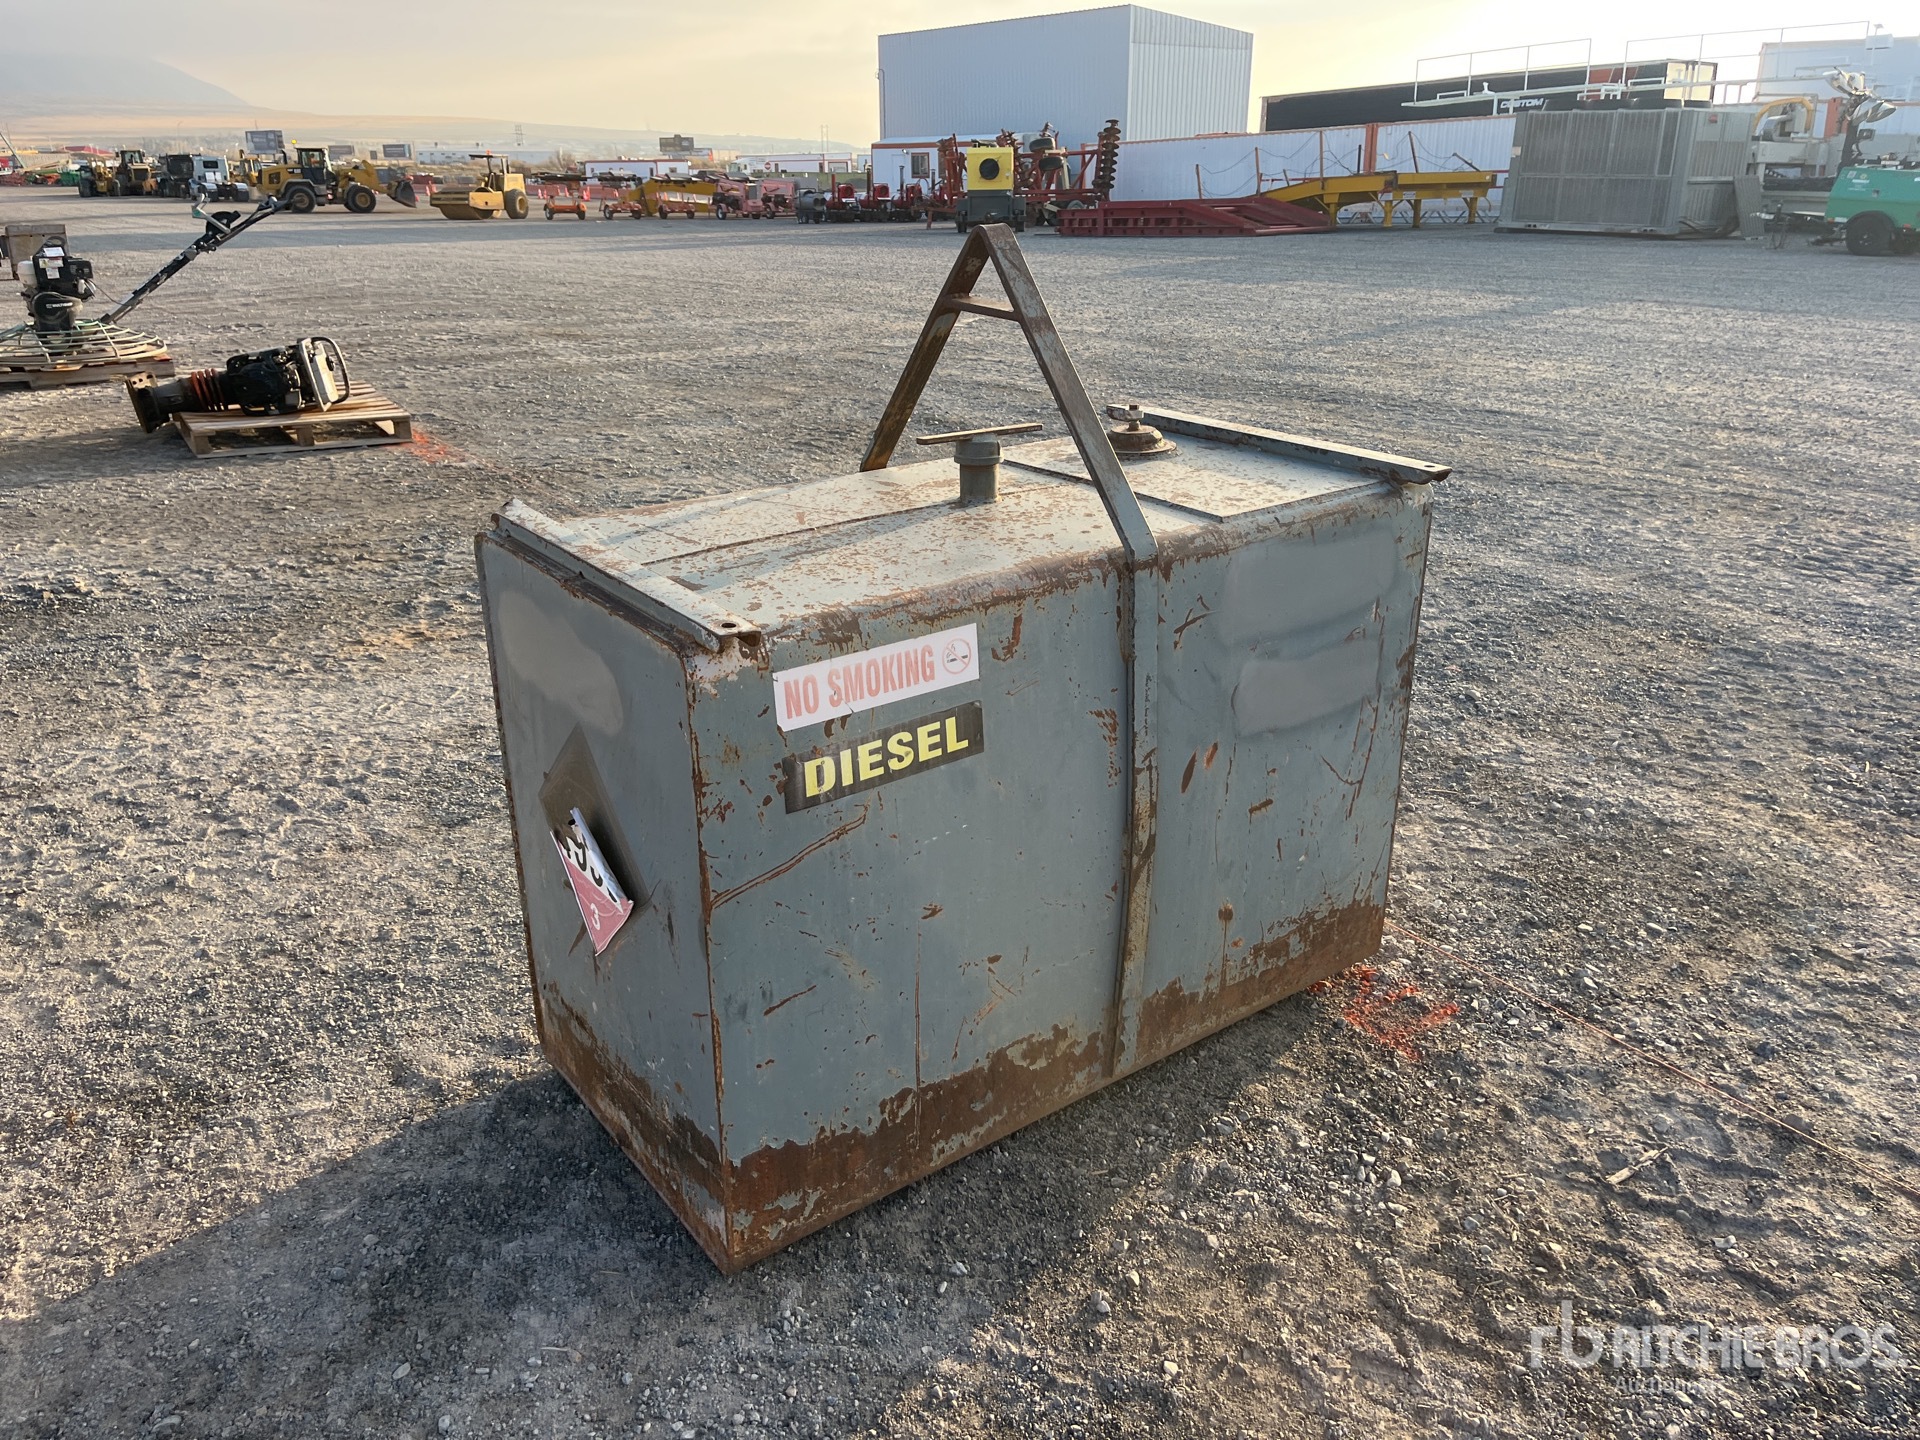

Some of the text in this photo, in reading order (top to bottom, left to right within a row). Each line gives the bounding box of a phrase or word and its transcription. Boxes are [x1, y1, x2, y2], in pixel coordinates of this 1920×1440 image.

[784, 644, 936, 720] NO SMOKING
[803, 716, 969, 798] DIESEL
[590, 902, 601, 931] 3
